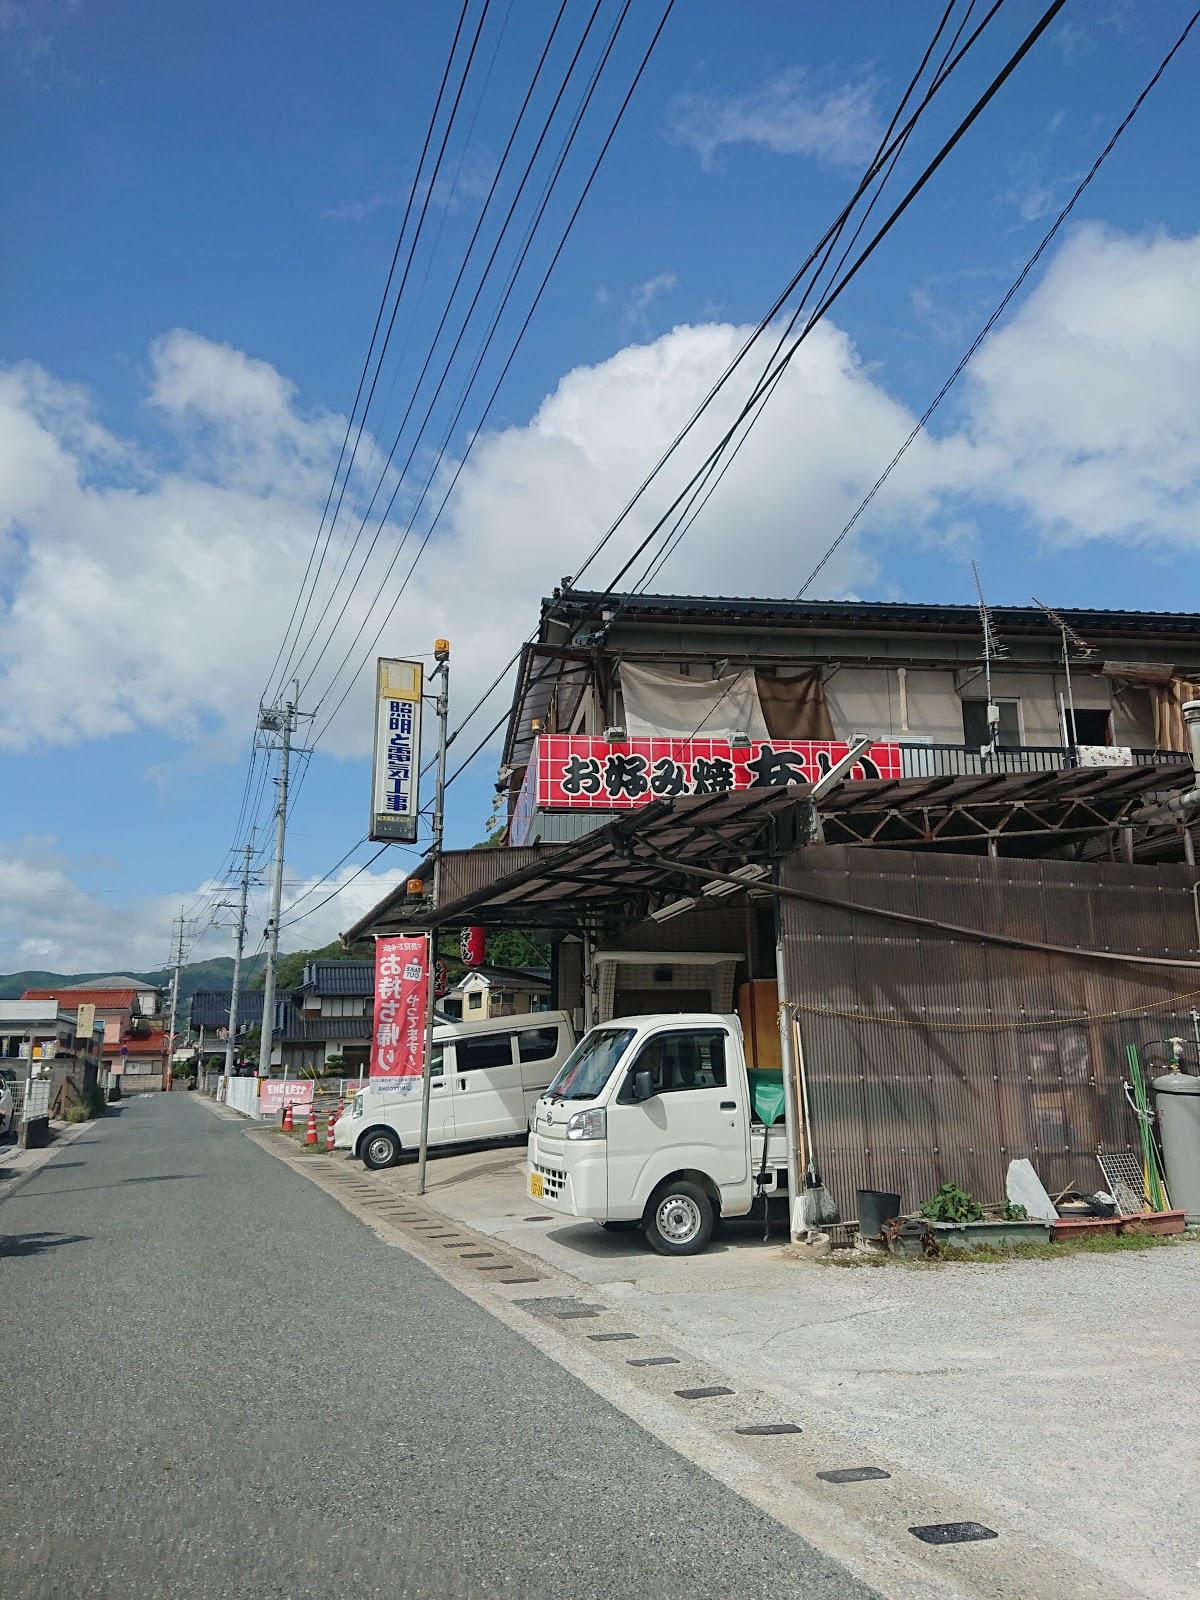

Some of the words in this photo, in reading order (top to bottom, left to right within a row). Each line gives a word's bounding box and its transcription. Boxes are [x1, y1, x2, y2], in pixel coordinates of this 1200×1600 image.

[386, 700, 413, 812] 照明と電気工事
